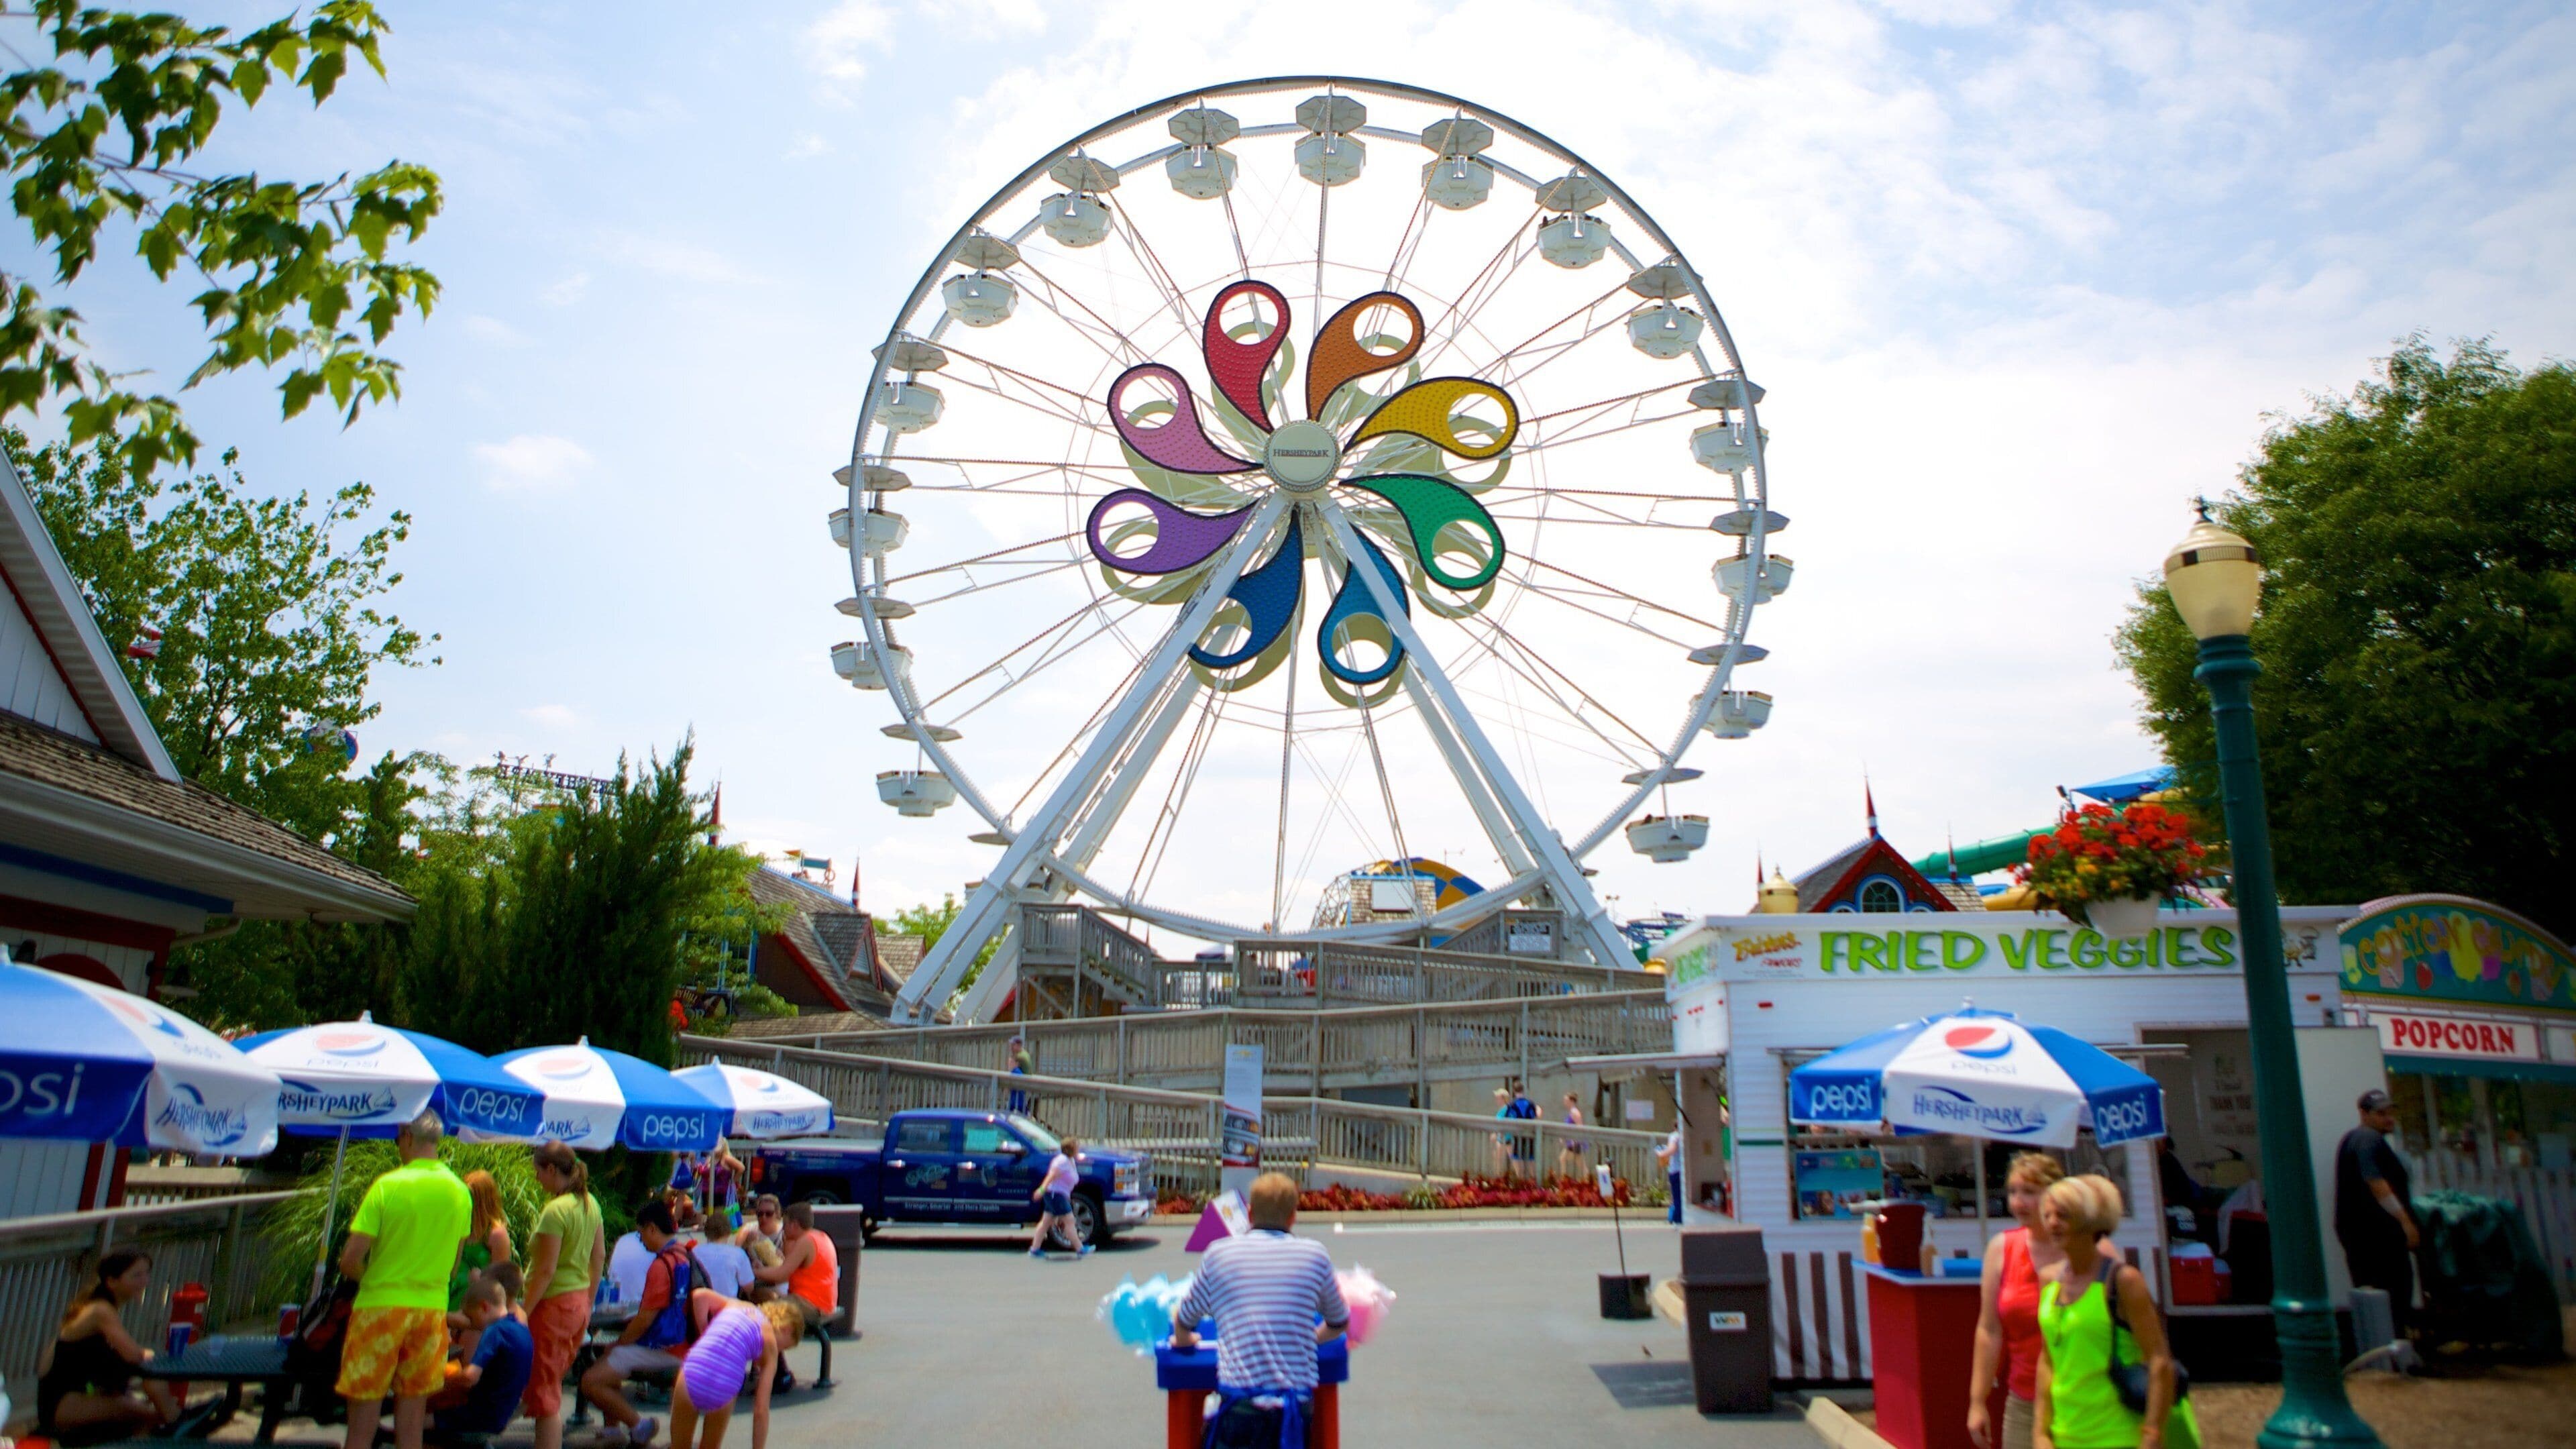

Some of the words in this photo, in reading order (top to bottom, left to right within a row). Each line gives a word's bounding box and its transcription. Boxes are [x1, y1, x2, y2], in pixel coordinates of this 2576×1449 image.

[1819, 930, 1986, 972] FRIED
[1998, 926, 2238, 970] VEGGIES
[2390, 1018, 2516, 1054] POPCORN
[1951, 1060, 2018, 1075] pepsi
[459, 1087, 531, 1126] pepsi
[1810, 1077, 1873, 1118] pepsi
[1913, 1093, 2025, 1127] HERSHEYPARK
[642, 1113, 705, 1144] pepsi
[753, 1112, 808, 1131] HERSHEYPARK
[2097, 1092, 2148, 1140] pepsi
